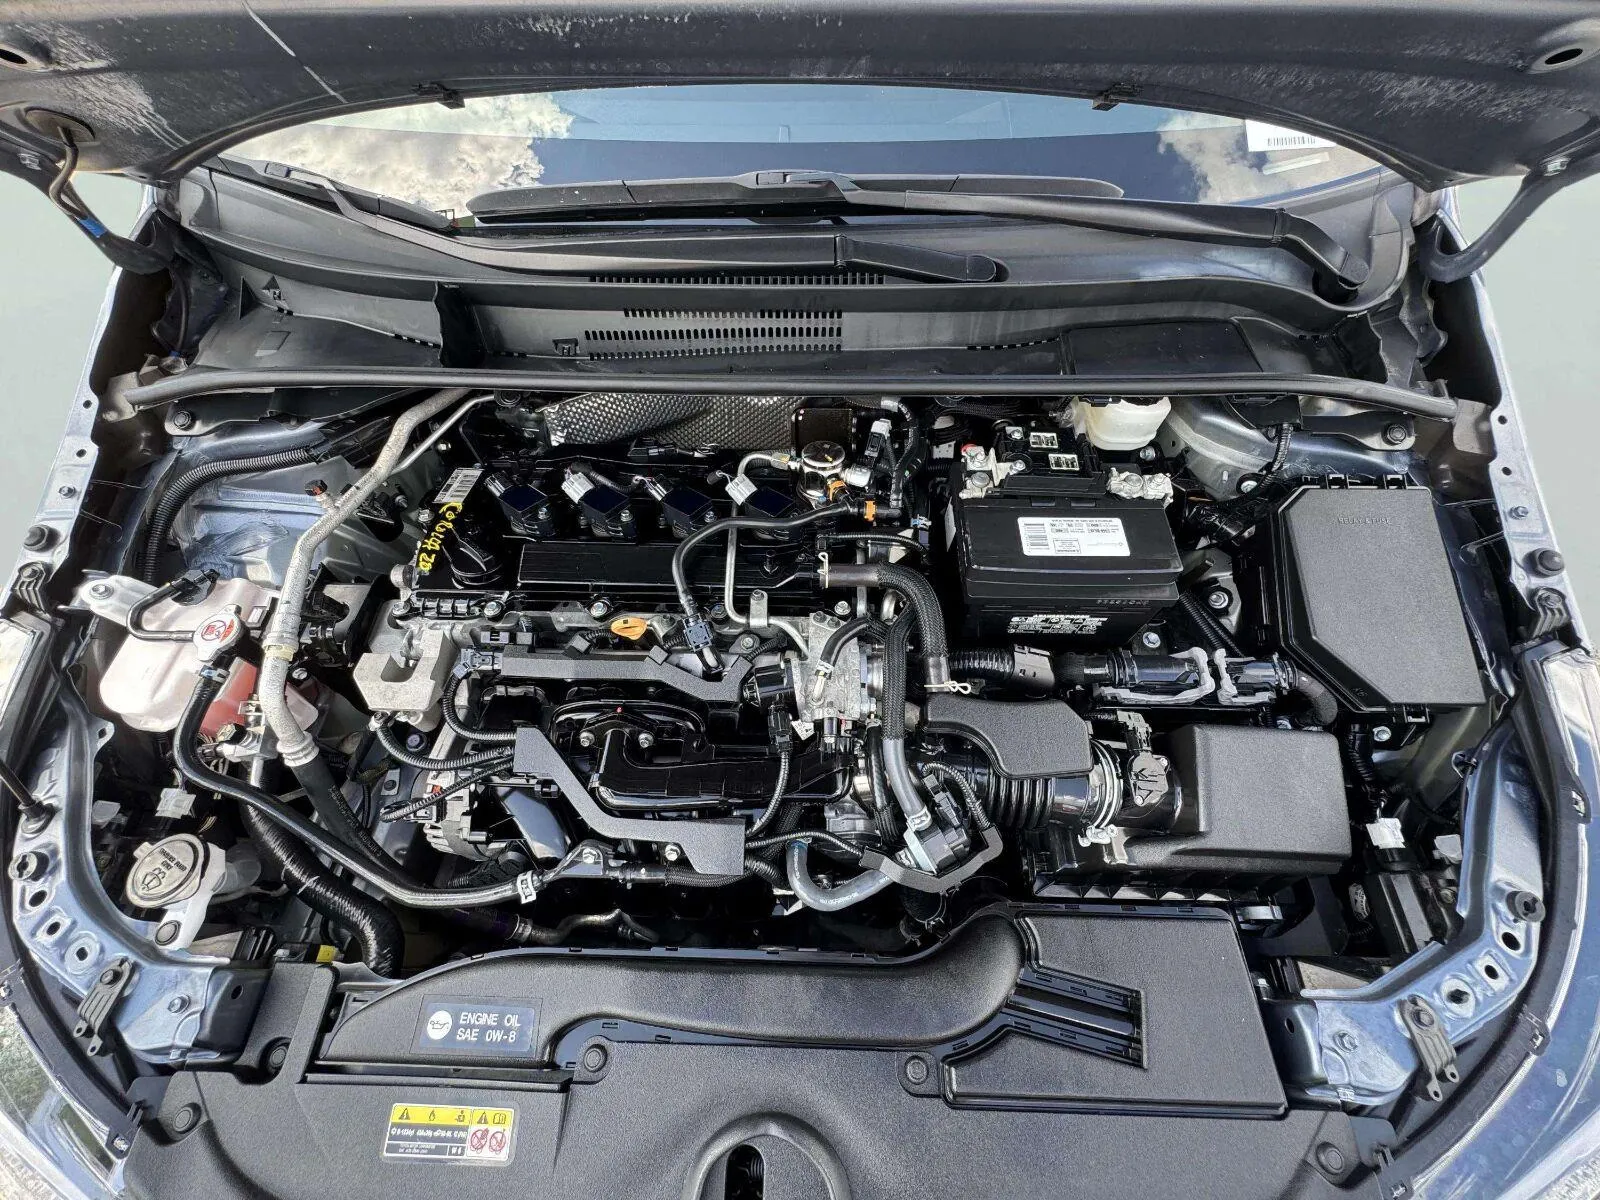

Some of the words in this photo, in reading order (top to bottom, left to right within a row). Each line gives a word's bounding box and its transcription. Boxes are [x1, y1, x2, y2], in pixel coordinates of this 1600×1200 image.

[459, 1012, 499, 1026] ENGINE
[504, 1014, 521, 1027] OIL
[456, 1028, 480, 1041] SAE
[486, 1030, 517, 1043] 0W-8
